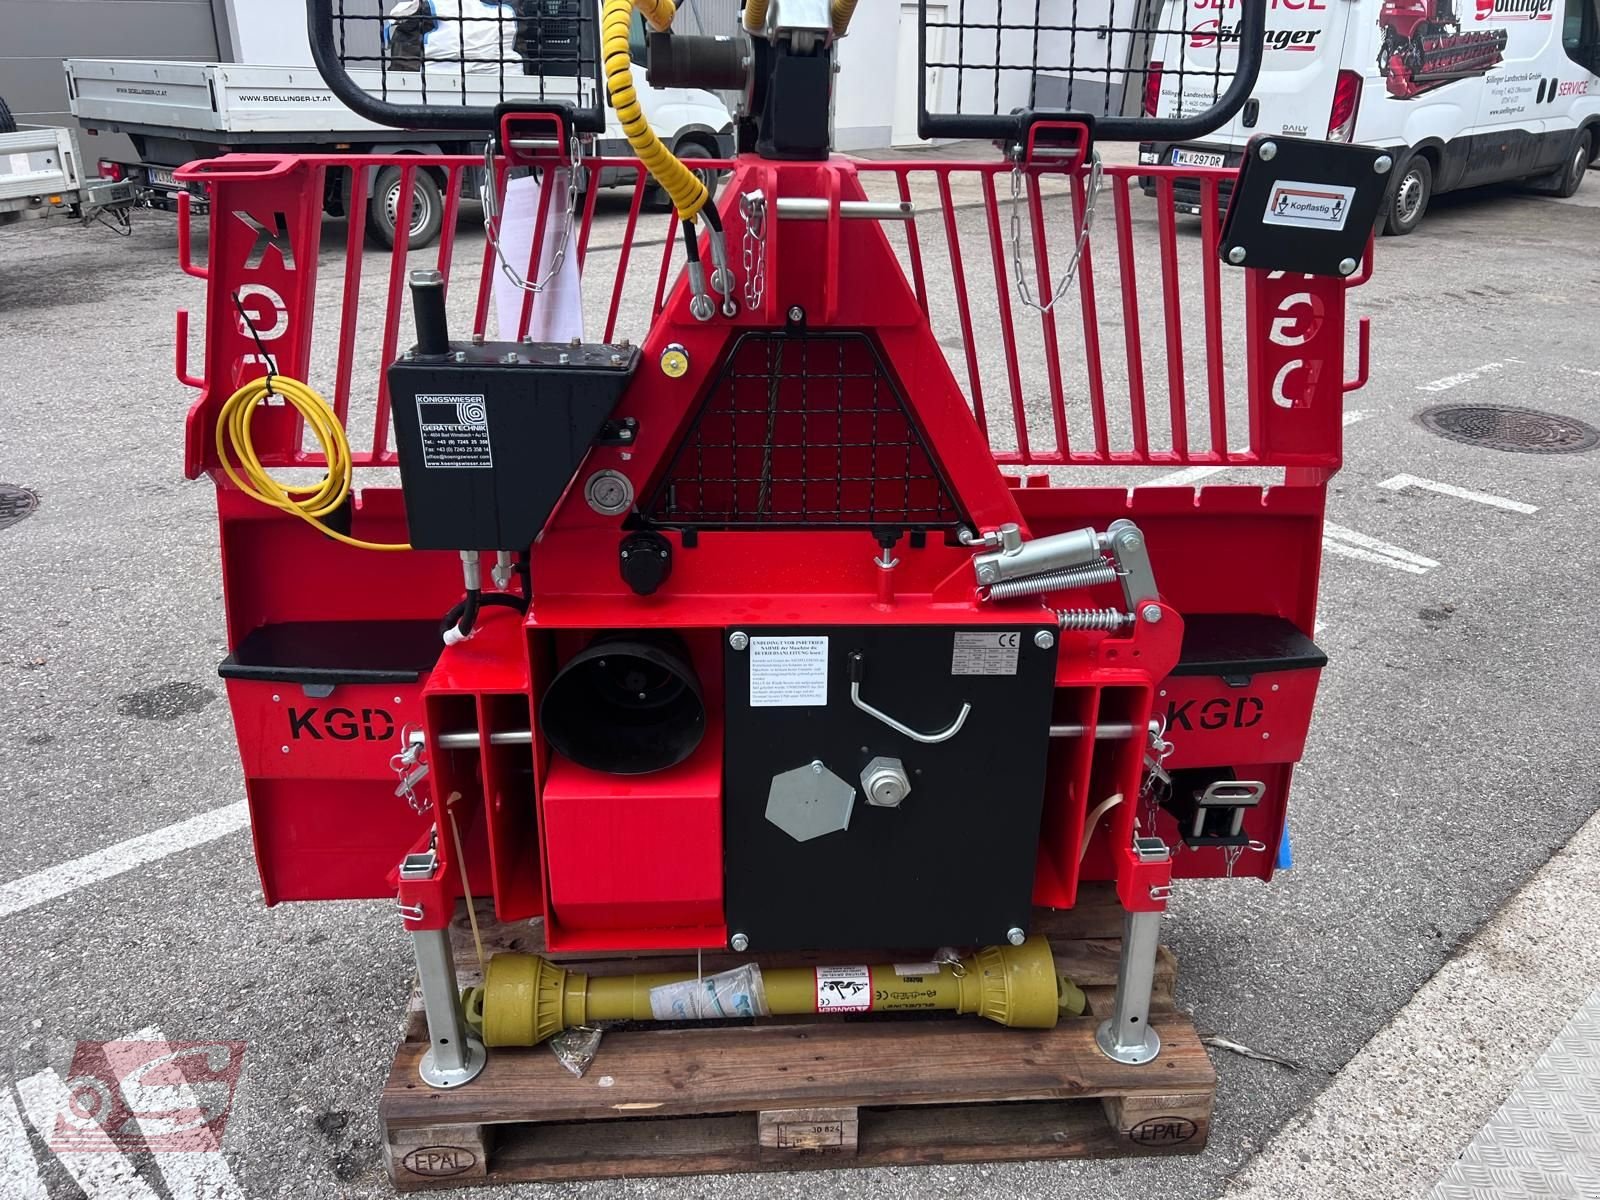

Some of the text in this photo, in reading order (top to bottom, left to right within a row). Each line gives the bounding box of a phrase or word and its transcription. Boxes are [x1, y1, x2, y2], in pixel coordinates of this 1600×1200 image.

[1558, 80, 1588, 96] SERVICE
[1194, 154, 1209, 165] 297
[1210, 156, 1222, 166] DR
[1290, 202, 1330, 214] Kopflastig
[1165, 697, 1264, 732] KGD
[288, 708, 394, 740] KGD
[1140, 1123, 1186, 1140] EPAL
[415, 1152, 468, 1170] EPAL
